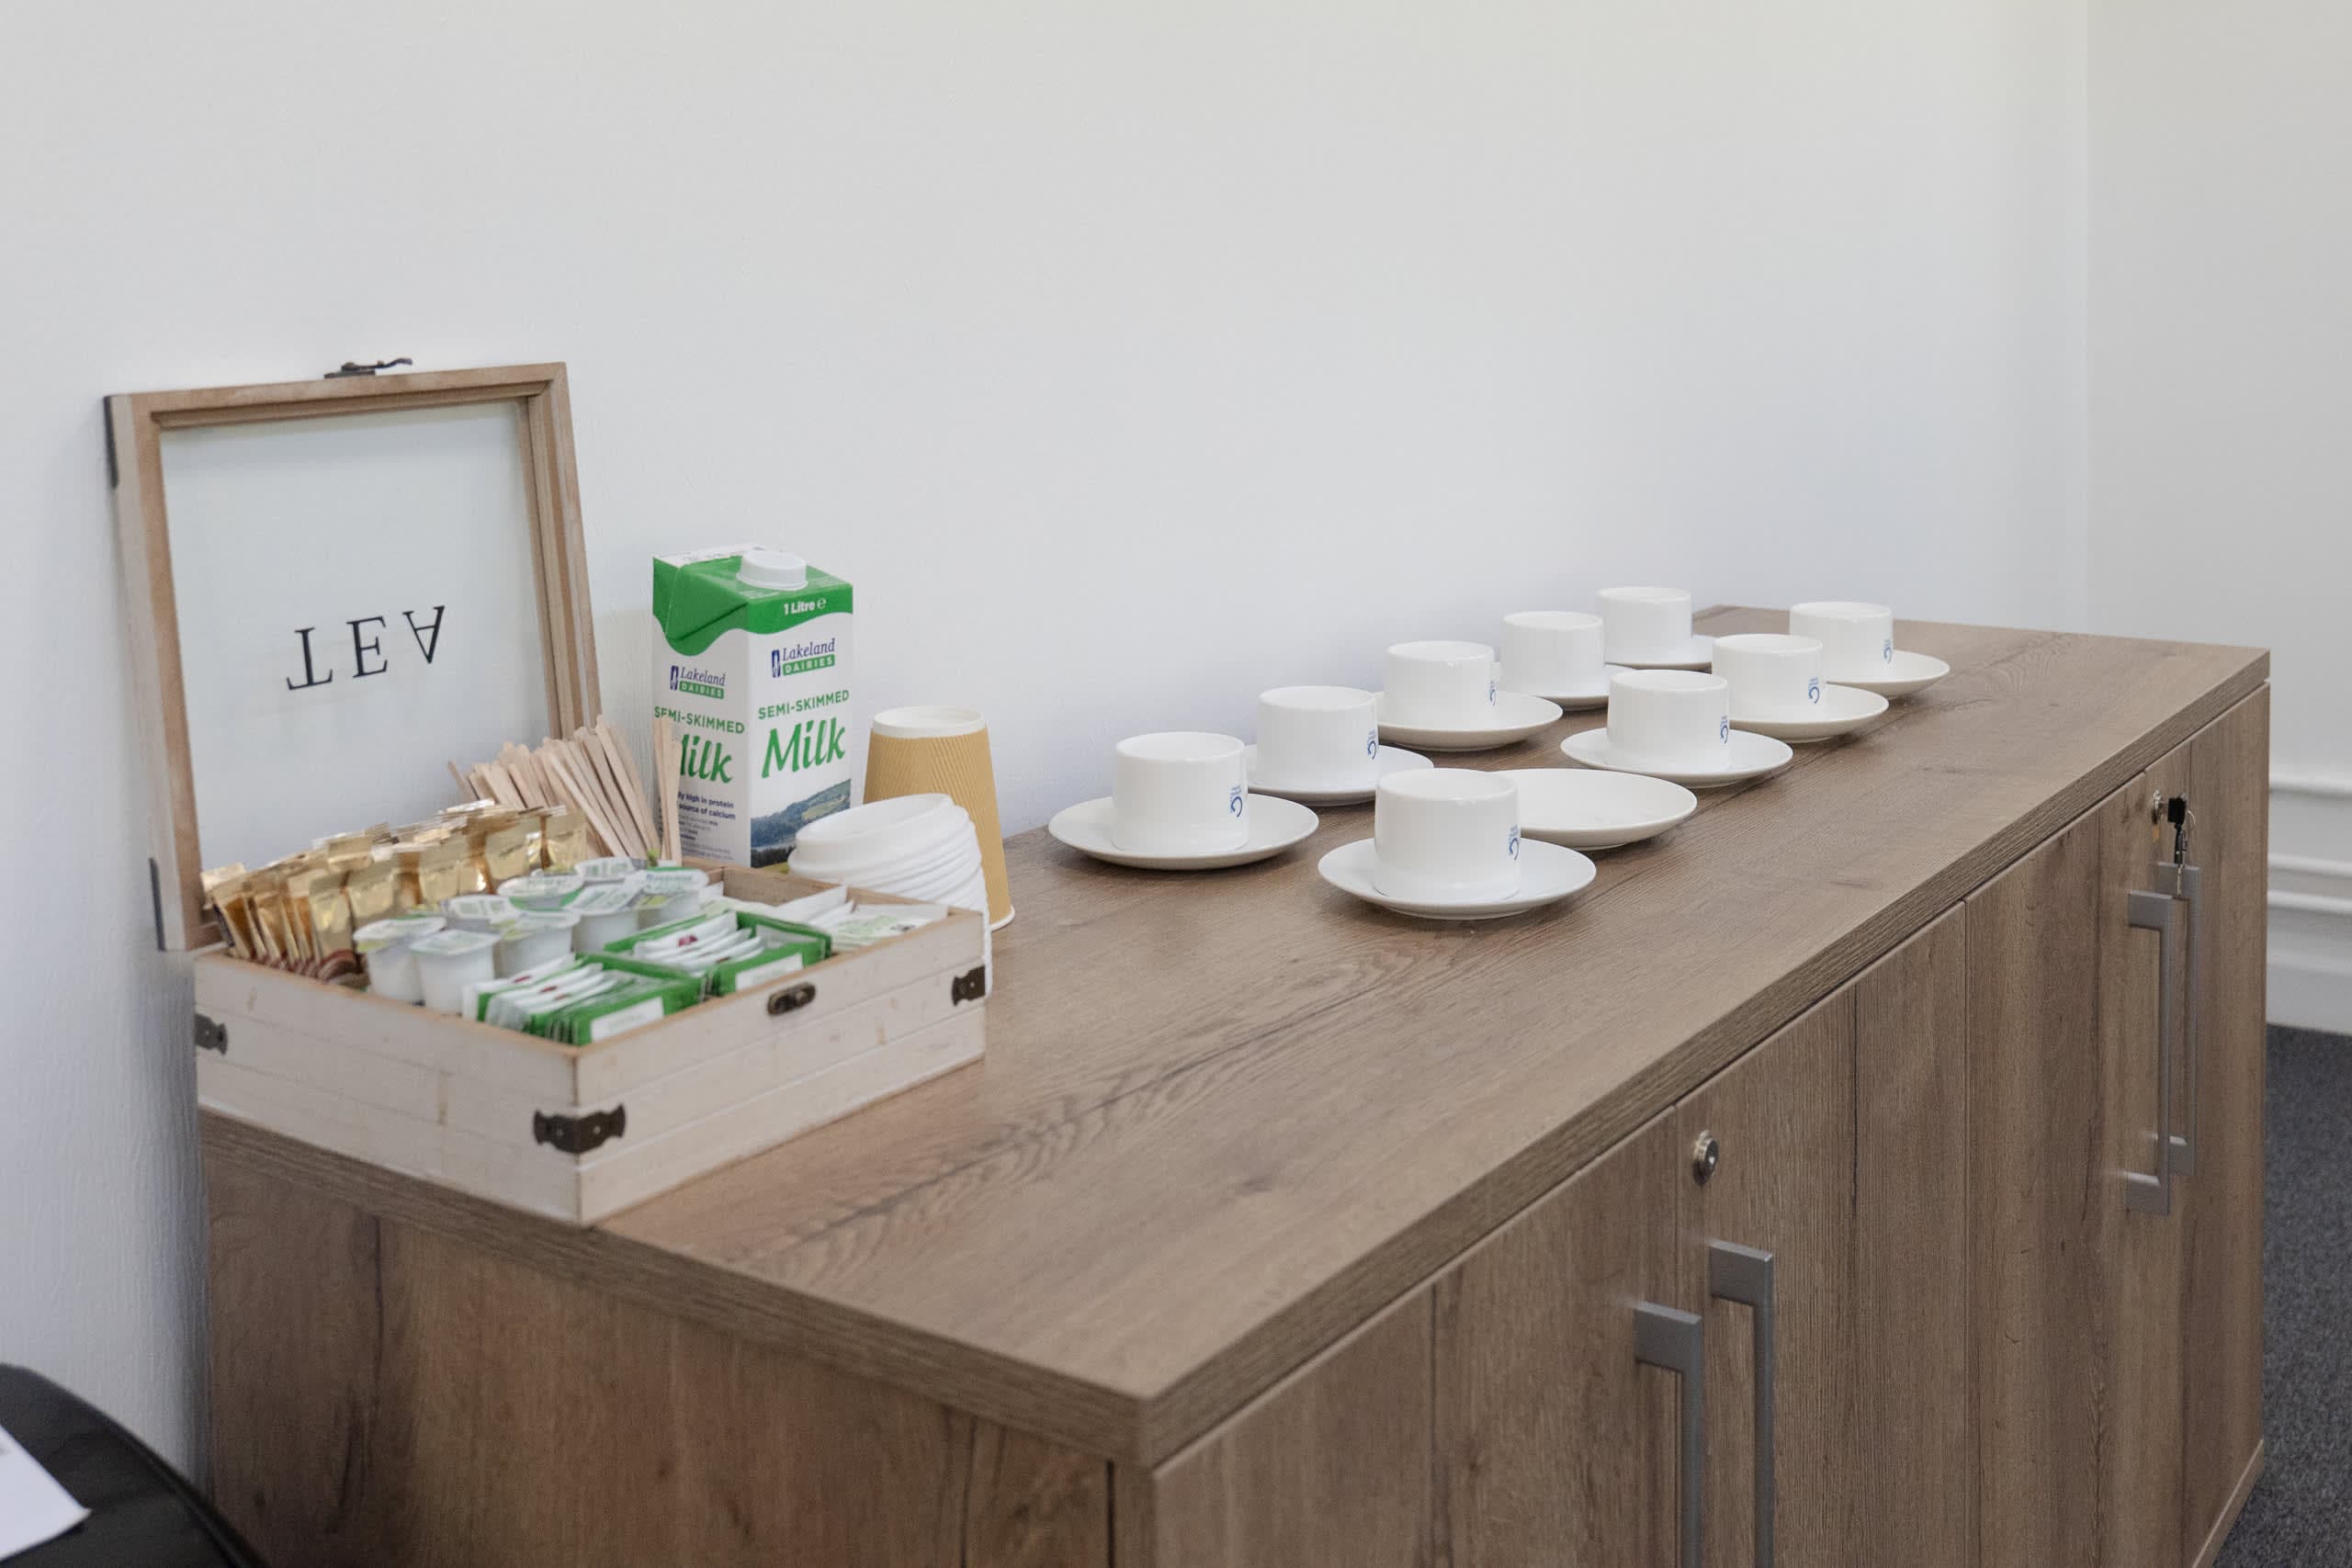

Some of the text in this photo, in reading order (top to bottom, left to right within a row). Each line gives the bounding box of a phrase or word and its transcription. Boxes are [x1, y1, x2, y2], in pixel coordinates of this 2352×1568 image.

[784, 603, 790, 615] 1
[791, 600, 816, 614] Litre
[783, 637, 835, 661] Lakeland
[785, 656, 833, 674] DAIRIES
[680, 666, 726, 686] Lakeland
[681, 682, 722, 698] DAIRIES
[758, 690, 850, 719] SEMI-SKIMMED
[762, 716, 846, 779] Milk
[701, 795, 708, 804] in
[709, 798, 734, 808] protein
[701, 807, 707, 815] of
